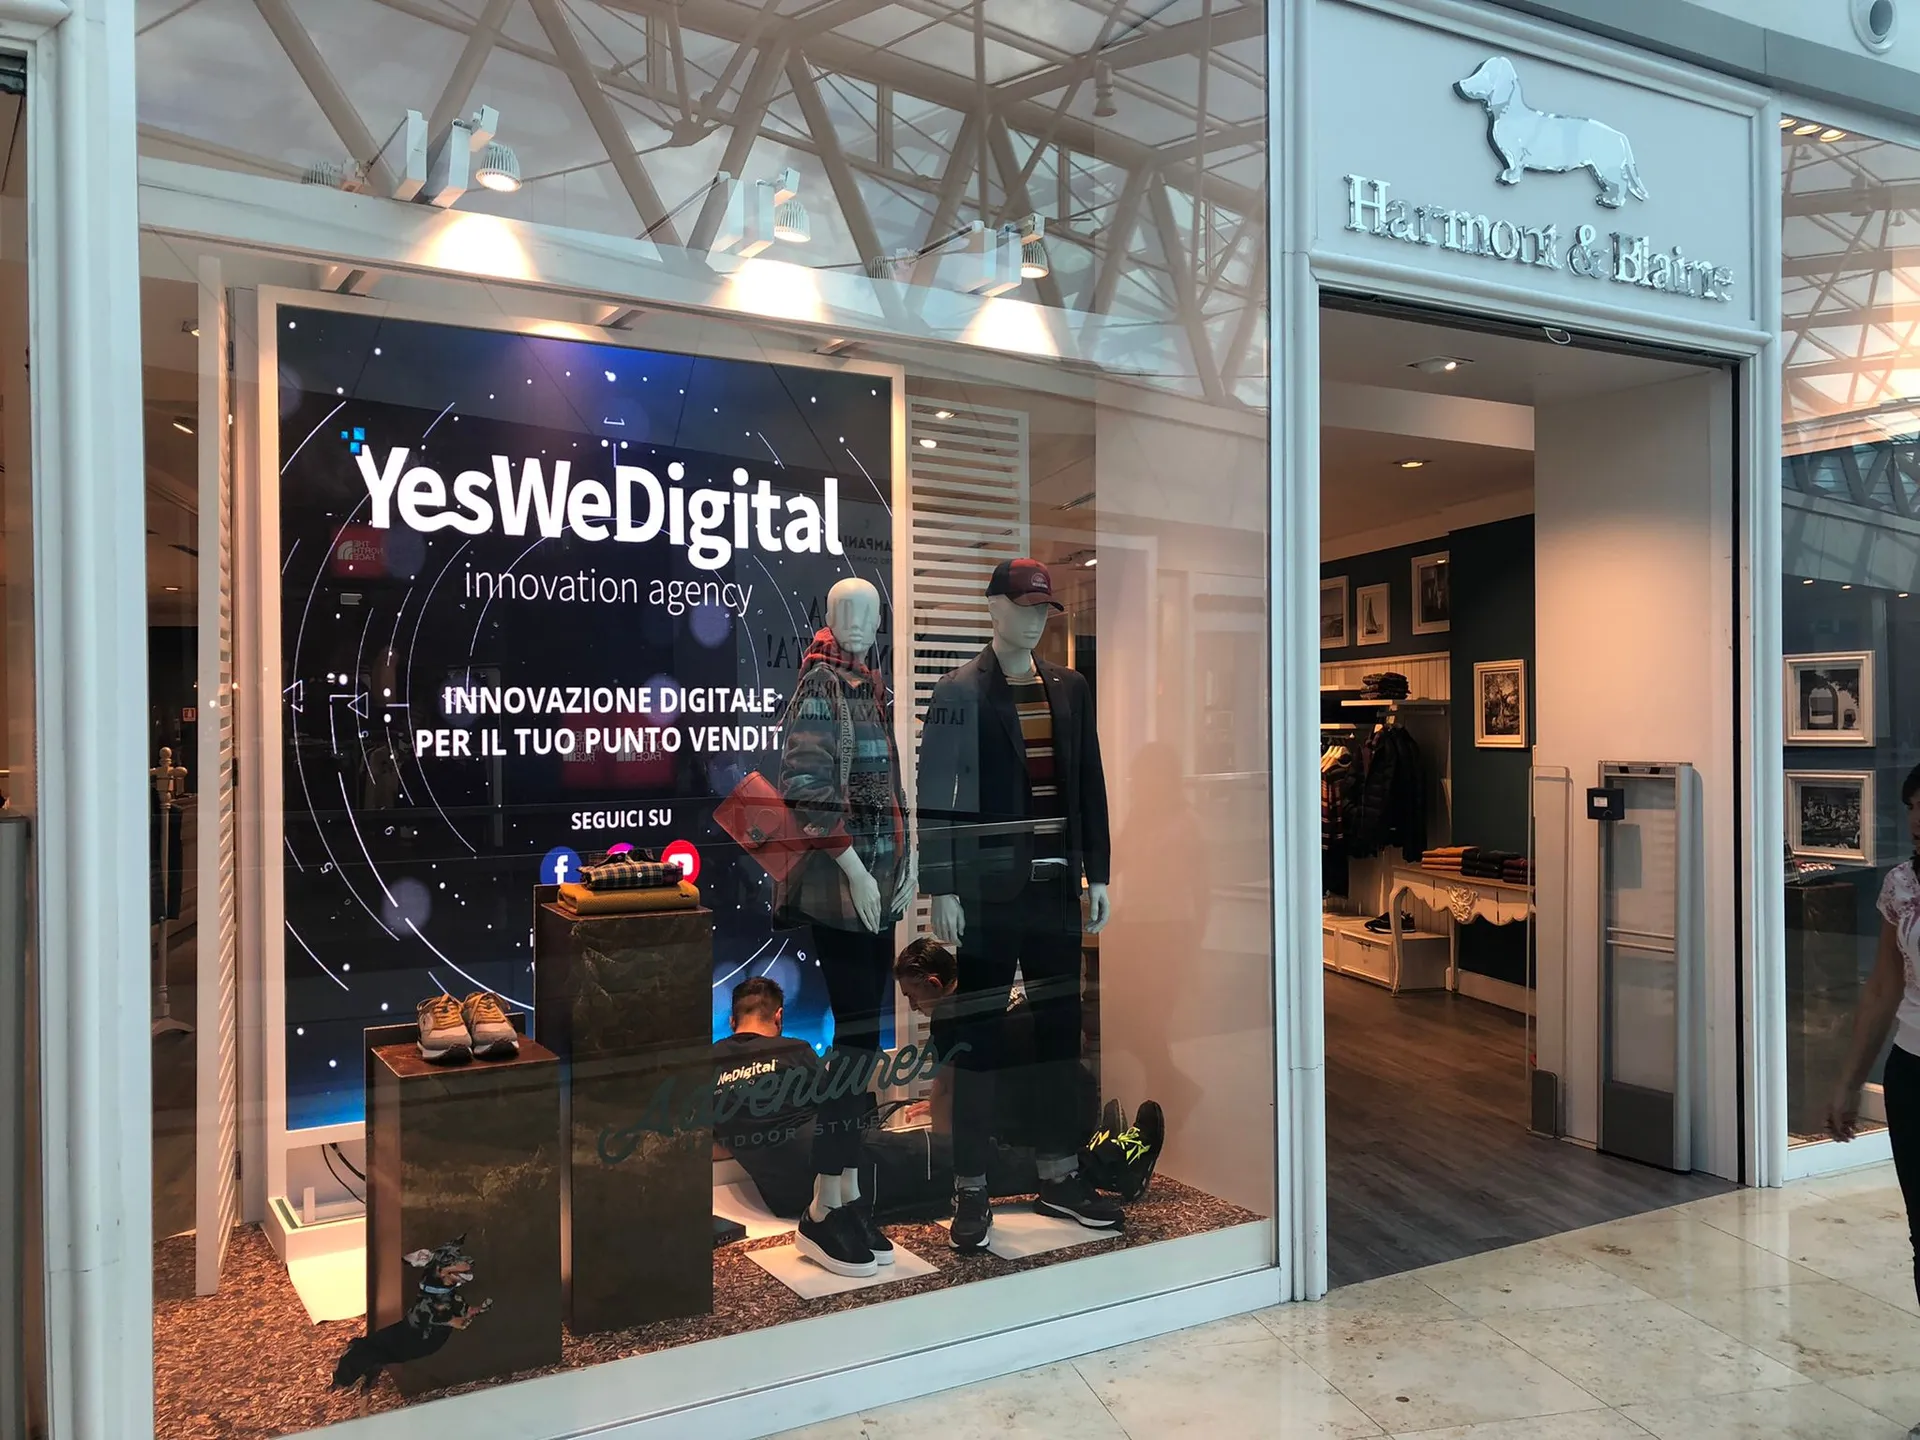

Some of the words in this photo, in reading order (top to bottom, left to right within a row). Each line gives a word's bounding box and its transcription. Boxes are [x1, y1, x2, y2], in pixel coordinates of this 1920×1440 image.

[1343, 173, 1562, 270] Harmont
[1567, 224, 1608, 279] &
[1608, 231, 1735, 301] Blaine
[355, 444, 844, 570] YesWeDigital
[465, 568, 638, 604] innovation
[649, 579, 753, 617] agency
[444, 686, 652, 714] INNOVAZIONE
[660, 687, 776, 713] DIGITALE
[415, 729, 472, 758] PER
[481, 729, 507, 756] IL
[514, 727, 576, 756] TUO
[585, 726, 682, 754] PUNTO
[688, 725, 784, 752] VENDIT
[571, 810, 644, 829] SEGUICI
[648, 809, 672, 826] SU
